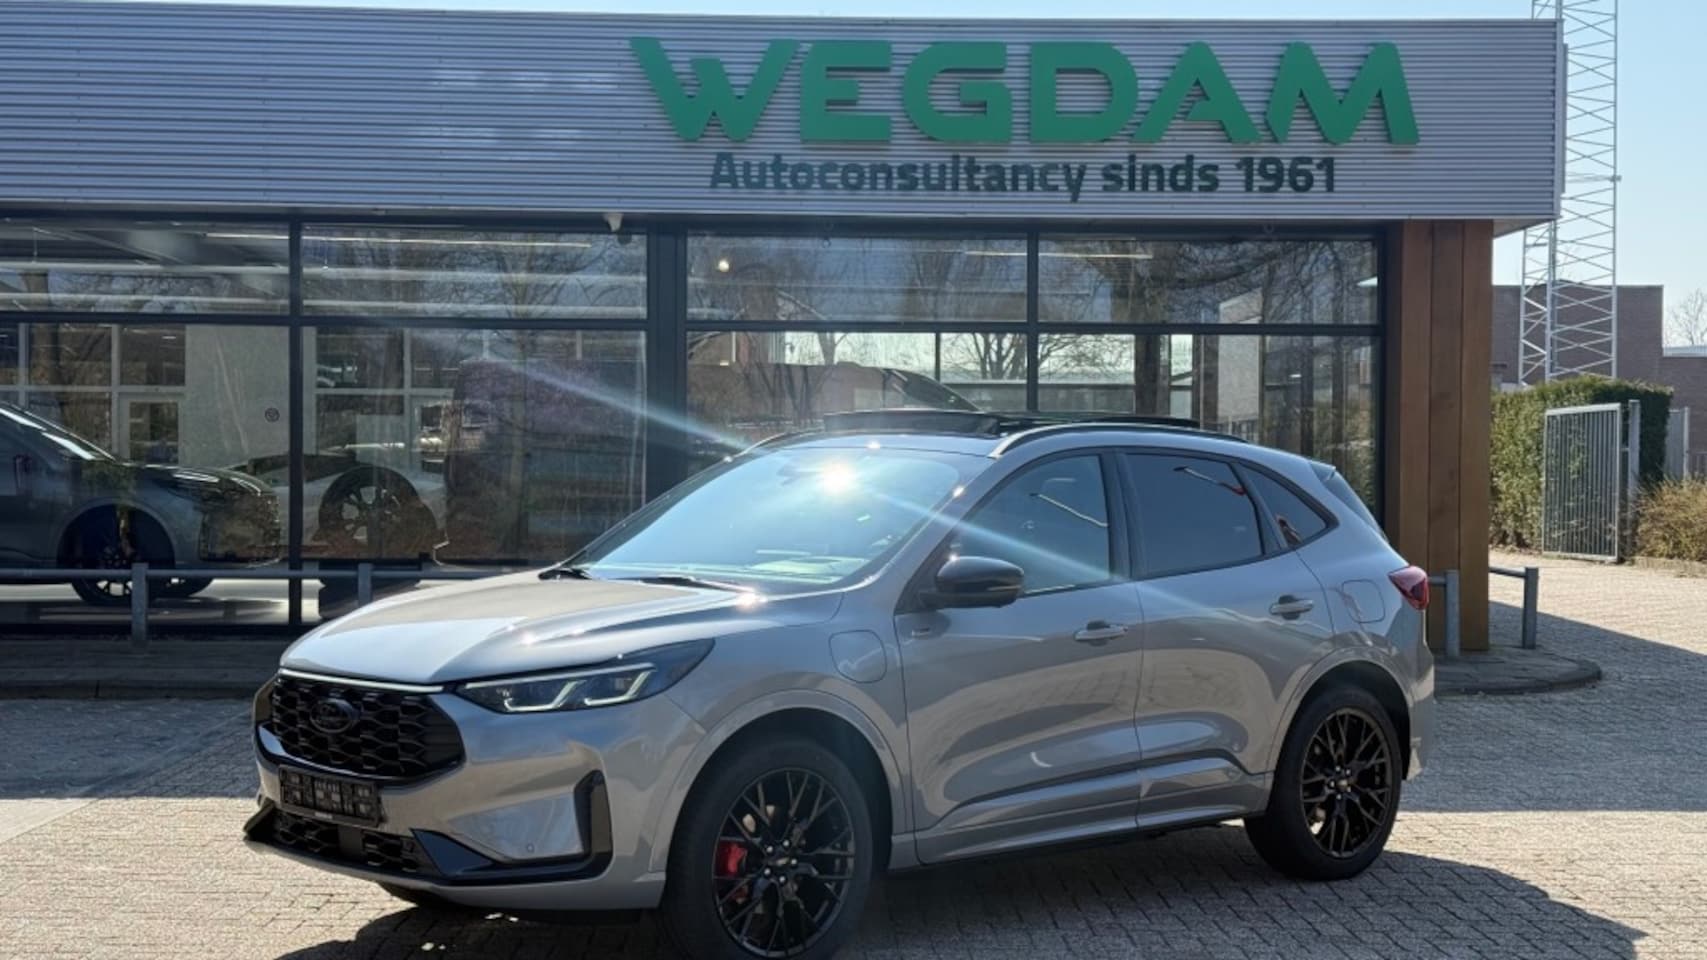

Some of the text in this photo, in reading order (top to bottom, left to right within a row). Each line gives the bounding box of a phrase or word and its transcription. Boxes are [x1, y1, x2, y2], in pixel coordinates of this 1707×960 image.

[630, 38, 1420, 145] WEGDAM
[710, 152, 1336, 202] Autoconsultancy sinds 1961
